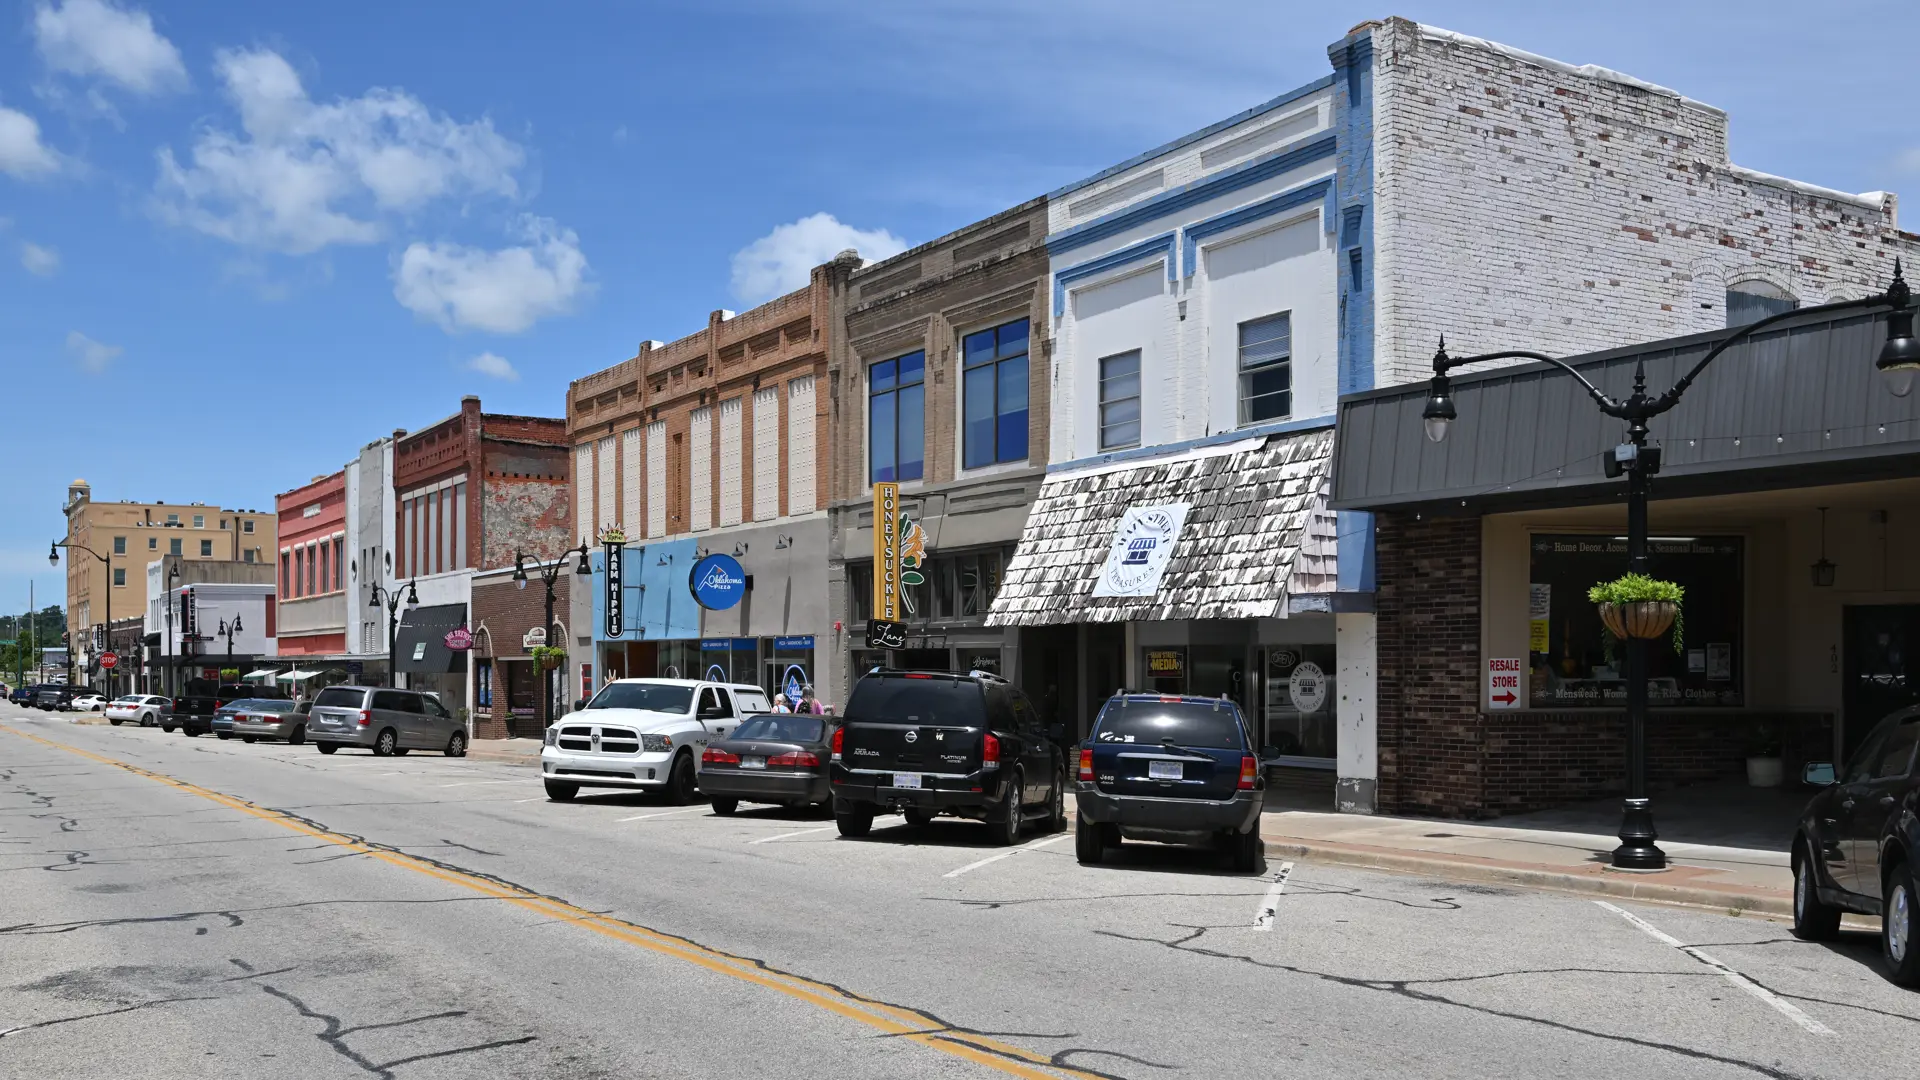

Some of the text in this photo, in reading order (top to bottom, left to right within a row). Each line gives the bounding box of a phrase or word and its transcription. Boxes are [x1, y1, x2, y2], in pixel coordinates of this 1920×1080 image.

[1118, 513, 1172, 546] MAIN STREET
[883, 487, 894, 619] HONEYSUCKLE
[1554, 542, 1577, 553] Home
[1656, 543, 1690, 554] Seasonal
[1692, 544, 1715, 554] Items
[708, 574, 743, 585] Oklahoma
[1111, 565, 1155, 588] TREASURES
[610, 545, 619, 634] FARM HIPPIE
[101, 656, 117, 664] STOP
[1151, 658, 1178, 671] MEDIA
[1272, 653, 1293, 665] OPEN
[1829, 643, 1839, 674] 402
[1489, 659, 1520, 671] RESALE
[1304, 664, 1324, 685] STREET
[1492, 676, 1518, 688] STORE
[1099, 774, 1115, 782] Jeep
